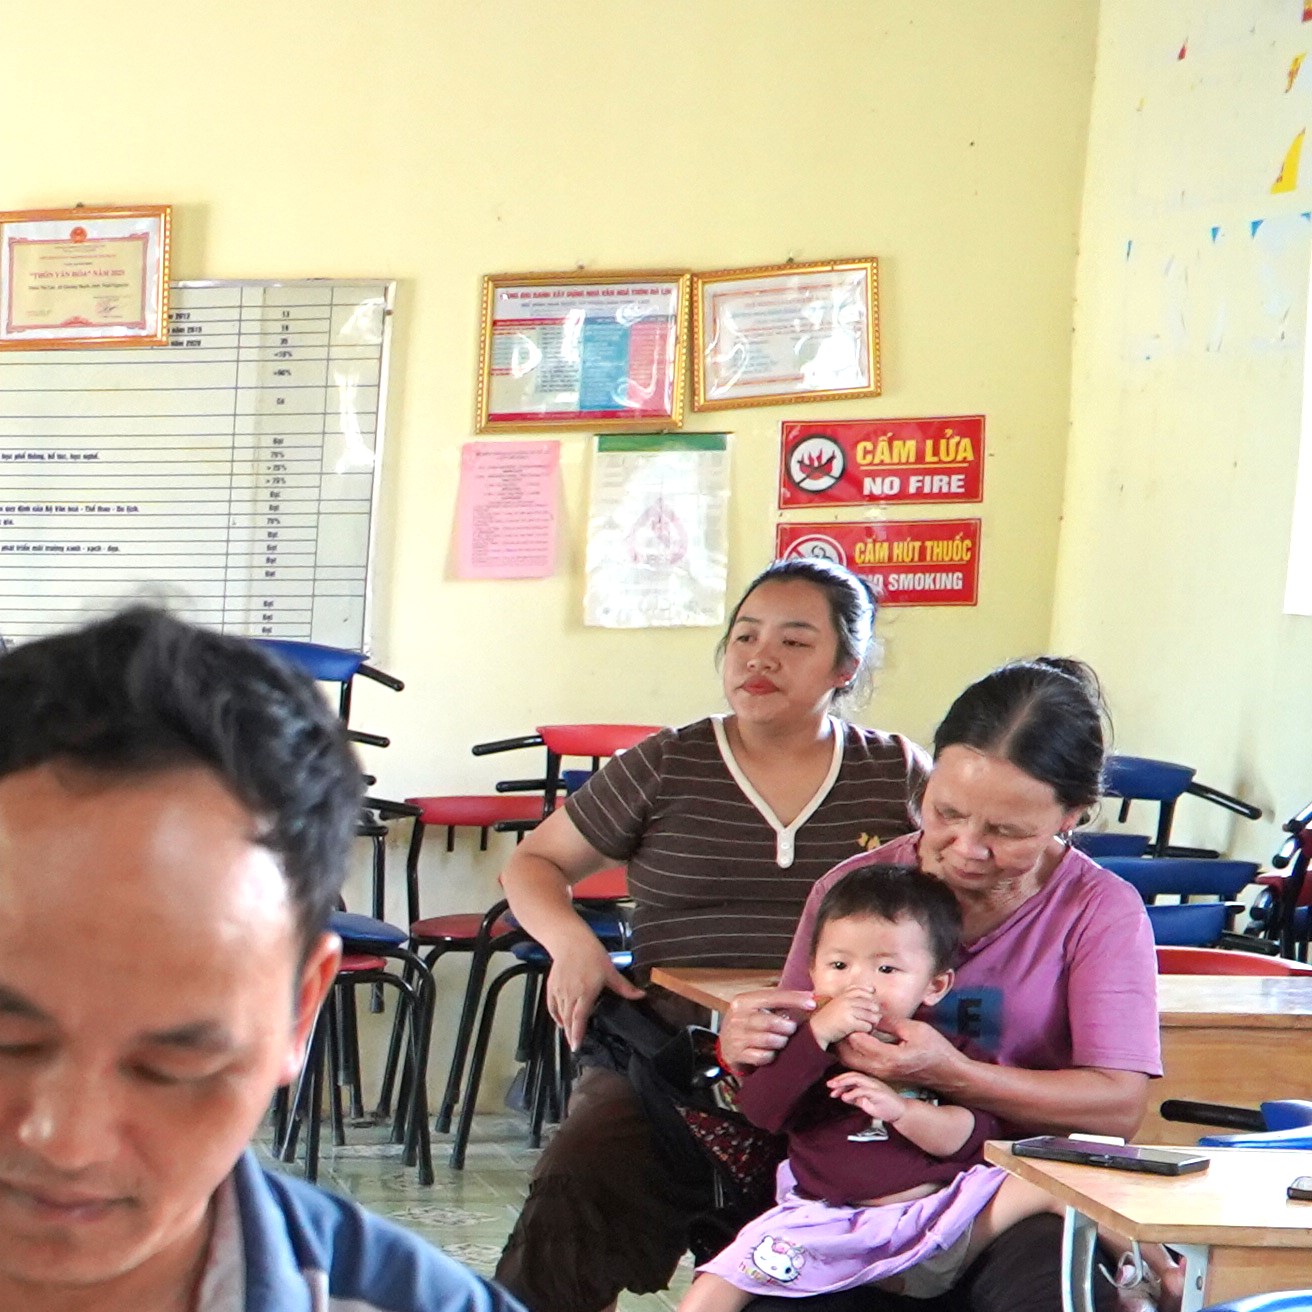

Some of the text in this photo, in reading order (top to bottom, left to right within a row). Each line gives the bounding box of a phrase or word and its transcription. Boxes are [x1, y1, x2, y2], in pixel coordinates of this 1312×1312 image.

[856, 428, 975, 465] CẤM LỬA
[863, 474, 965, 496] NO FIRE
[892, 537, 922, 562] HÚT
[925, 532, 972, 561] THUỐC
[888, 571, 964, 591] SMOKING
